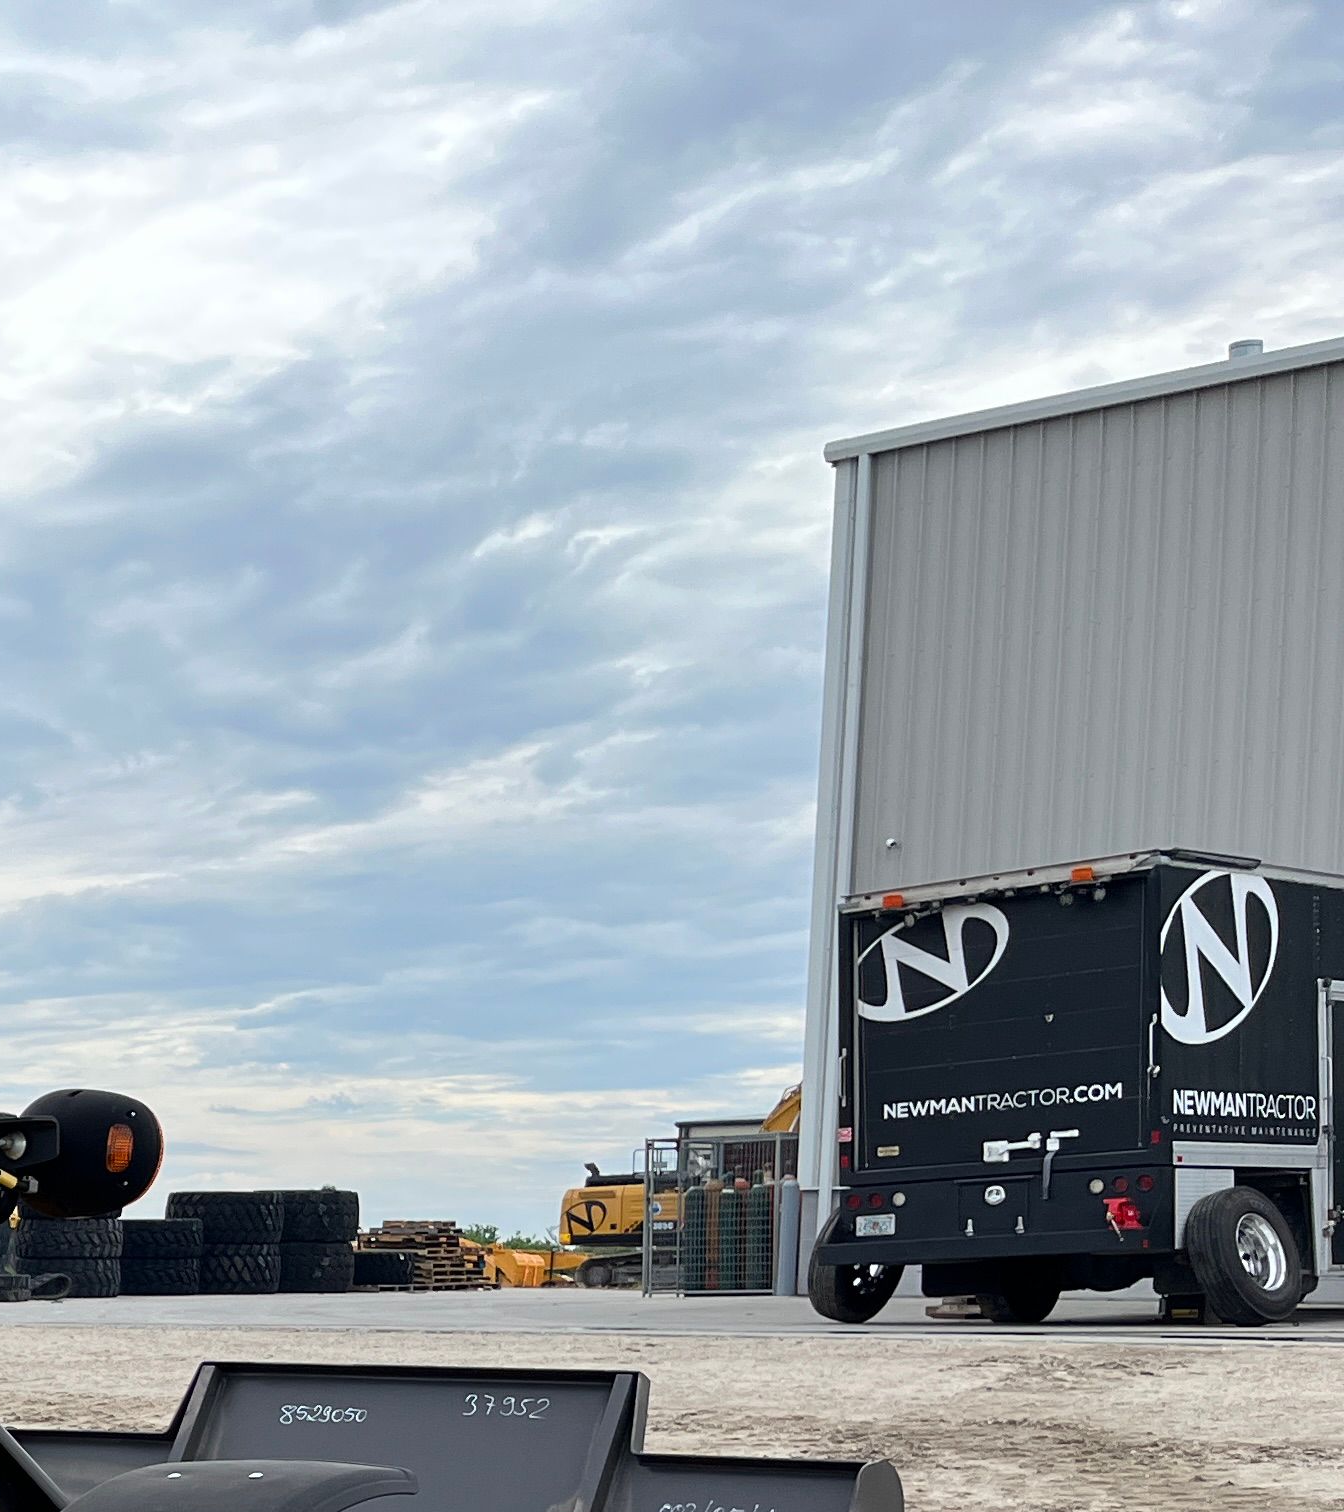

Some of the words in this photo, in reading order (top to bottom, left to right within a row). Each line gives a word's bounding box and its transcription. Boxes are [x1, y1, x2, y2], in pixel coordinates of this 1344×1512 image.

[883, 1082, 1124, 1120] NEWMANTRACTOR.COM
[1172, 1089, 1316, 1120] NEWMANTRACTOR
[1173, 1123, 1246, 1136] PREVENTATIVE
[1251, 1126, 1317, 1139] MAINTENANCE
[463, 1394, 550, 1419] 37952
